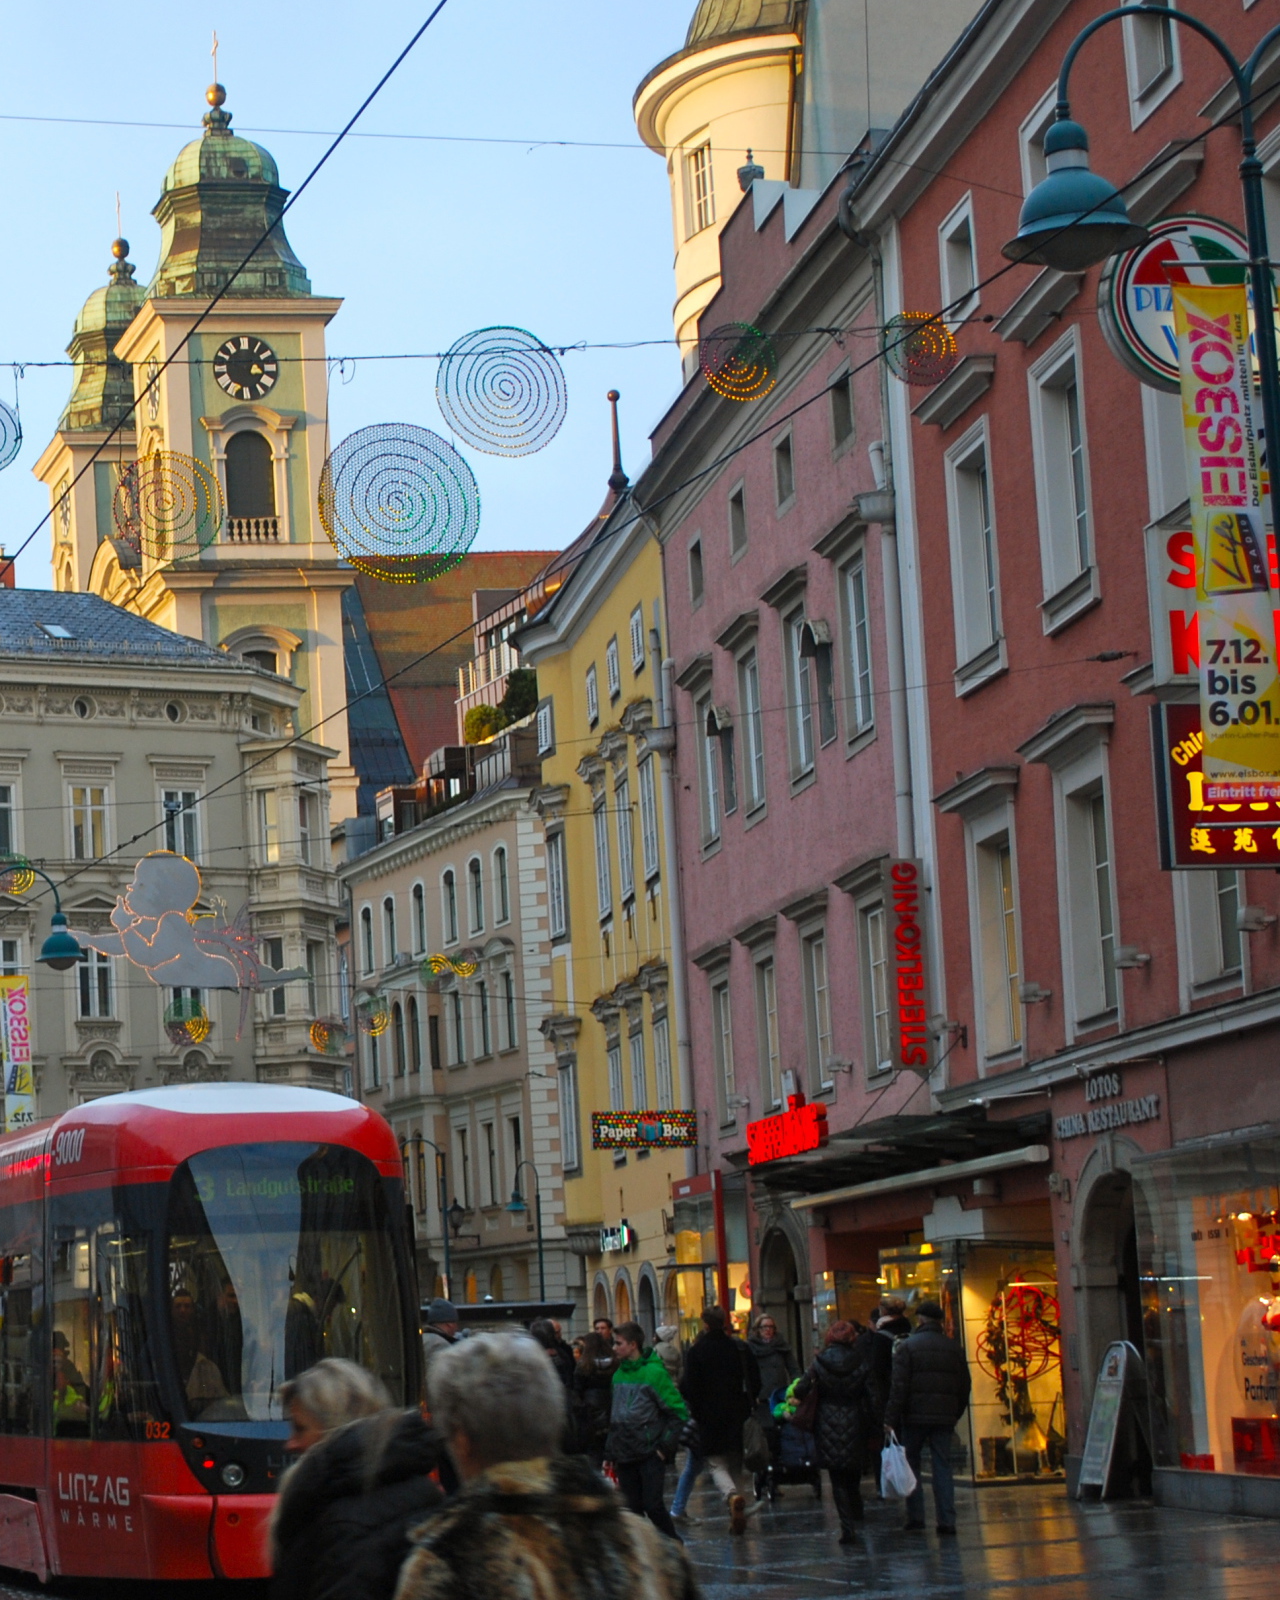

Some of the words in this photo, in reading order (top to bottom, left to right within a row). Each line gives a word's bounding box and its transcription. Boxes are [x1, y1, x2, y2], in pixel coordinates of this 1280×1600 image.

[1234, 314, 1243, 340] Linz
[1237, 358, 1250, 401] mitten
[1243, 405, 1258, 482] Eislaufplatz
[1251, 485, 1260, 507] Der
[1240, 520, 1261, 574] RADIO
[1206, 639, 1269, 664] 7.12.
[1207, 669, 1257, 695] bis
[1208, 700, 1280, 726] 6.01.
[1208, 786, 1256, 799] Eintritt
[1085, 1073, 1119, 1102] LOTOS
[1056, 1113, 1086, 1139] CHINA
[1087, 1094, 1160, 1133] RESTAURANT
[599, 1125, 638, 1141] Paper
[663, 1124, 688, 1136] Box
[194, 1175, 216, 1202] 3
[226, 1177, 355, 1198] Landgutstraße
[145, 1421, 170, 1439] 032
[103, 1475, 130, 1507] AG
[60, 1505, 133, 1532] WÄRME
